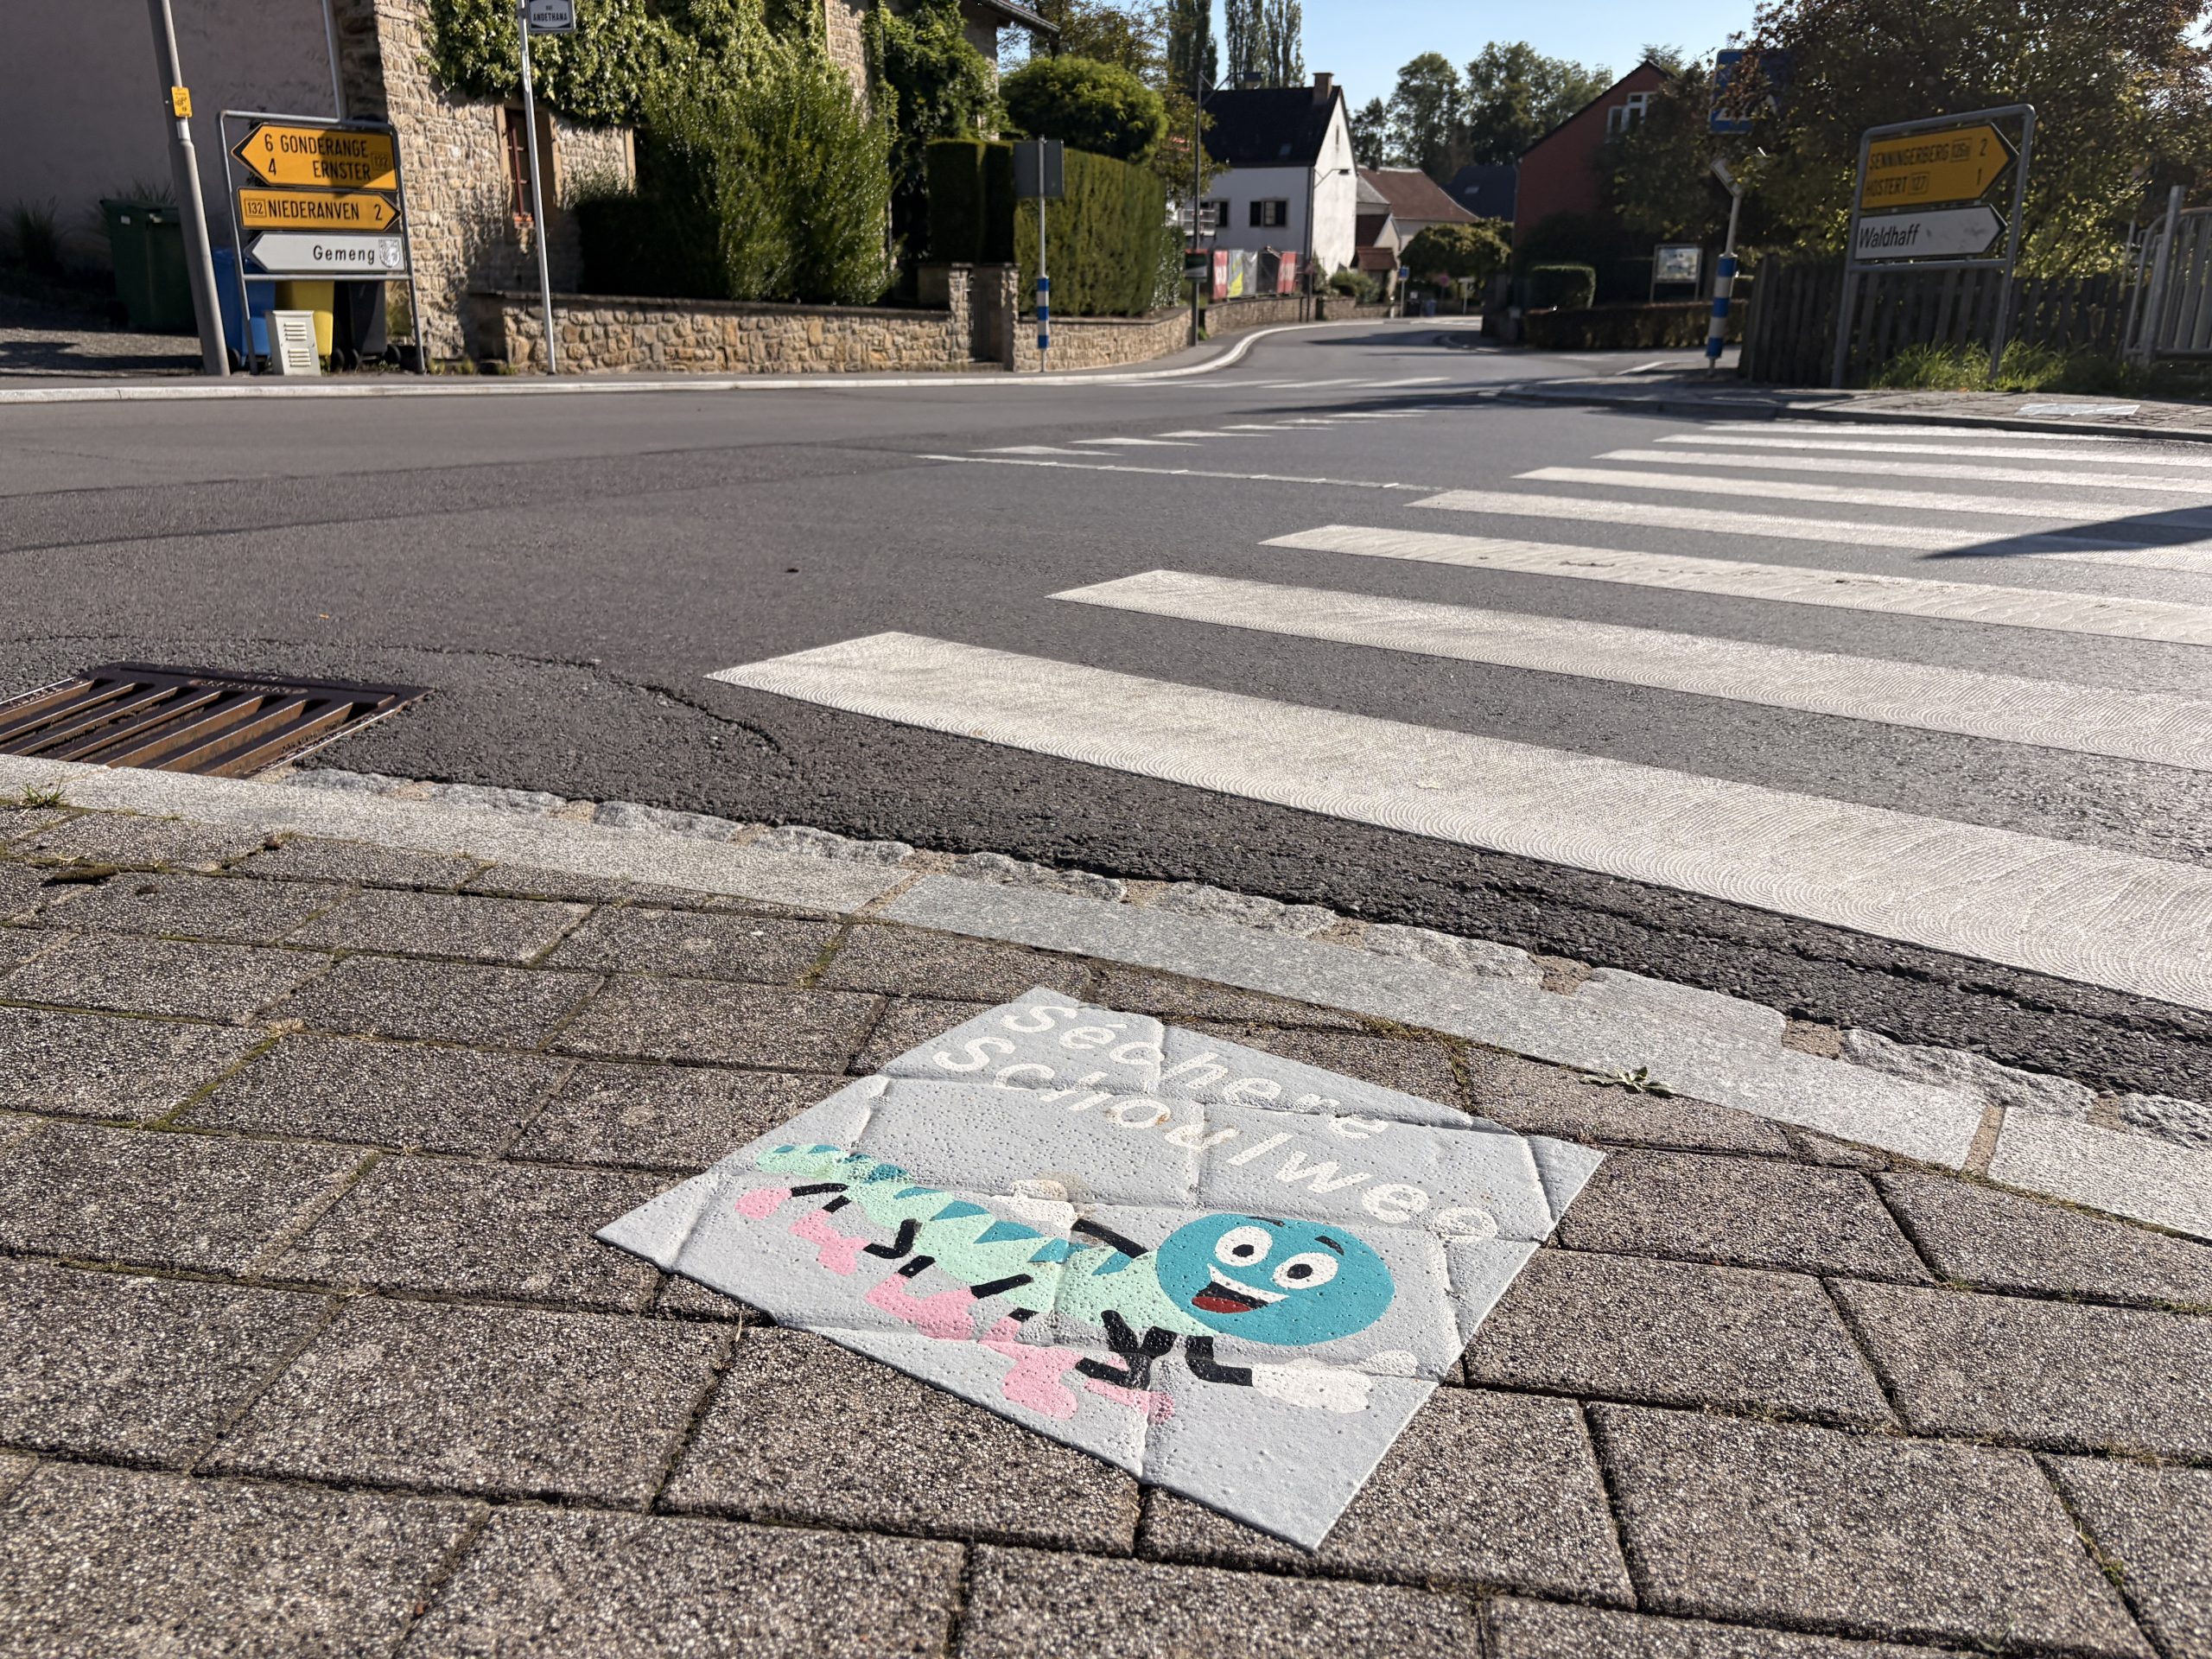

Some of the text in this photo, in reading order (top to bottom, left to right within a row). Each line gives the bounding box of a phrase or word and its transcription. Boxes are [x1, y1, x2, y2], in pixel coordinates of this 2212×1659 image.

[264, 133, 369, 158] 6 GONDERANGE
[1869, 143, 1950, 170] SENNINGERBERG
[1979, 138, 1987, 157] 2
[268, 158, 372, 181] 4 ERNSTER
[1866, 175, 1908, 197] HOSTERT
[1976, 168, 1982, 186] 1
[247, 199, 383, 221] 132 NIEDERANVEN 2
[1859, 223, 1921, 248] Waldhaff
[313, 245, 375, 264] Gemeng
